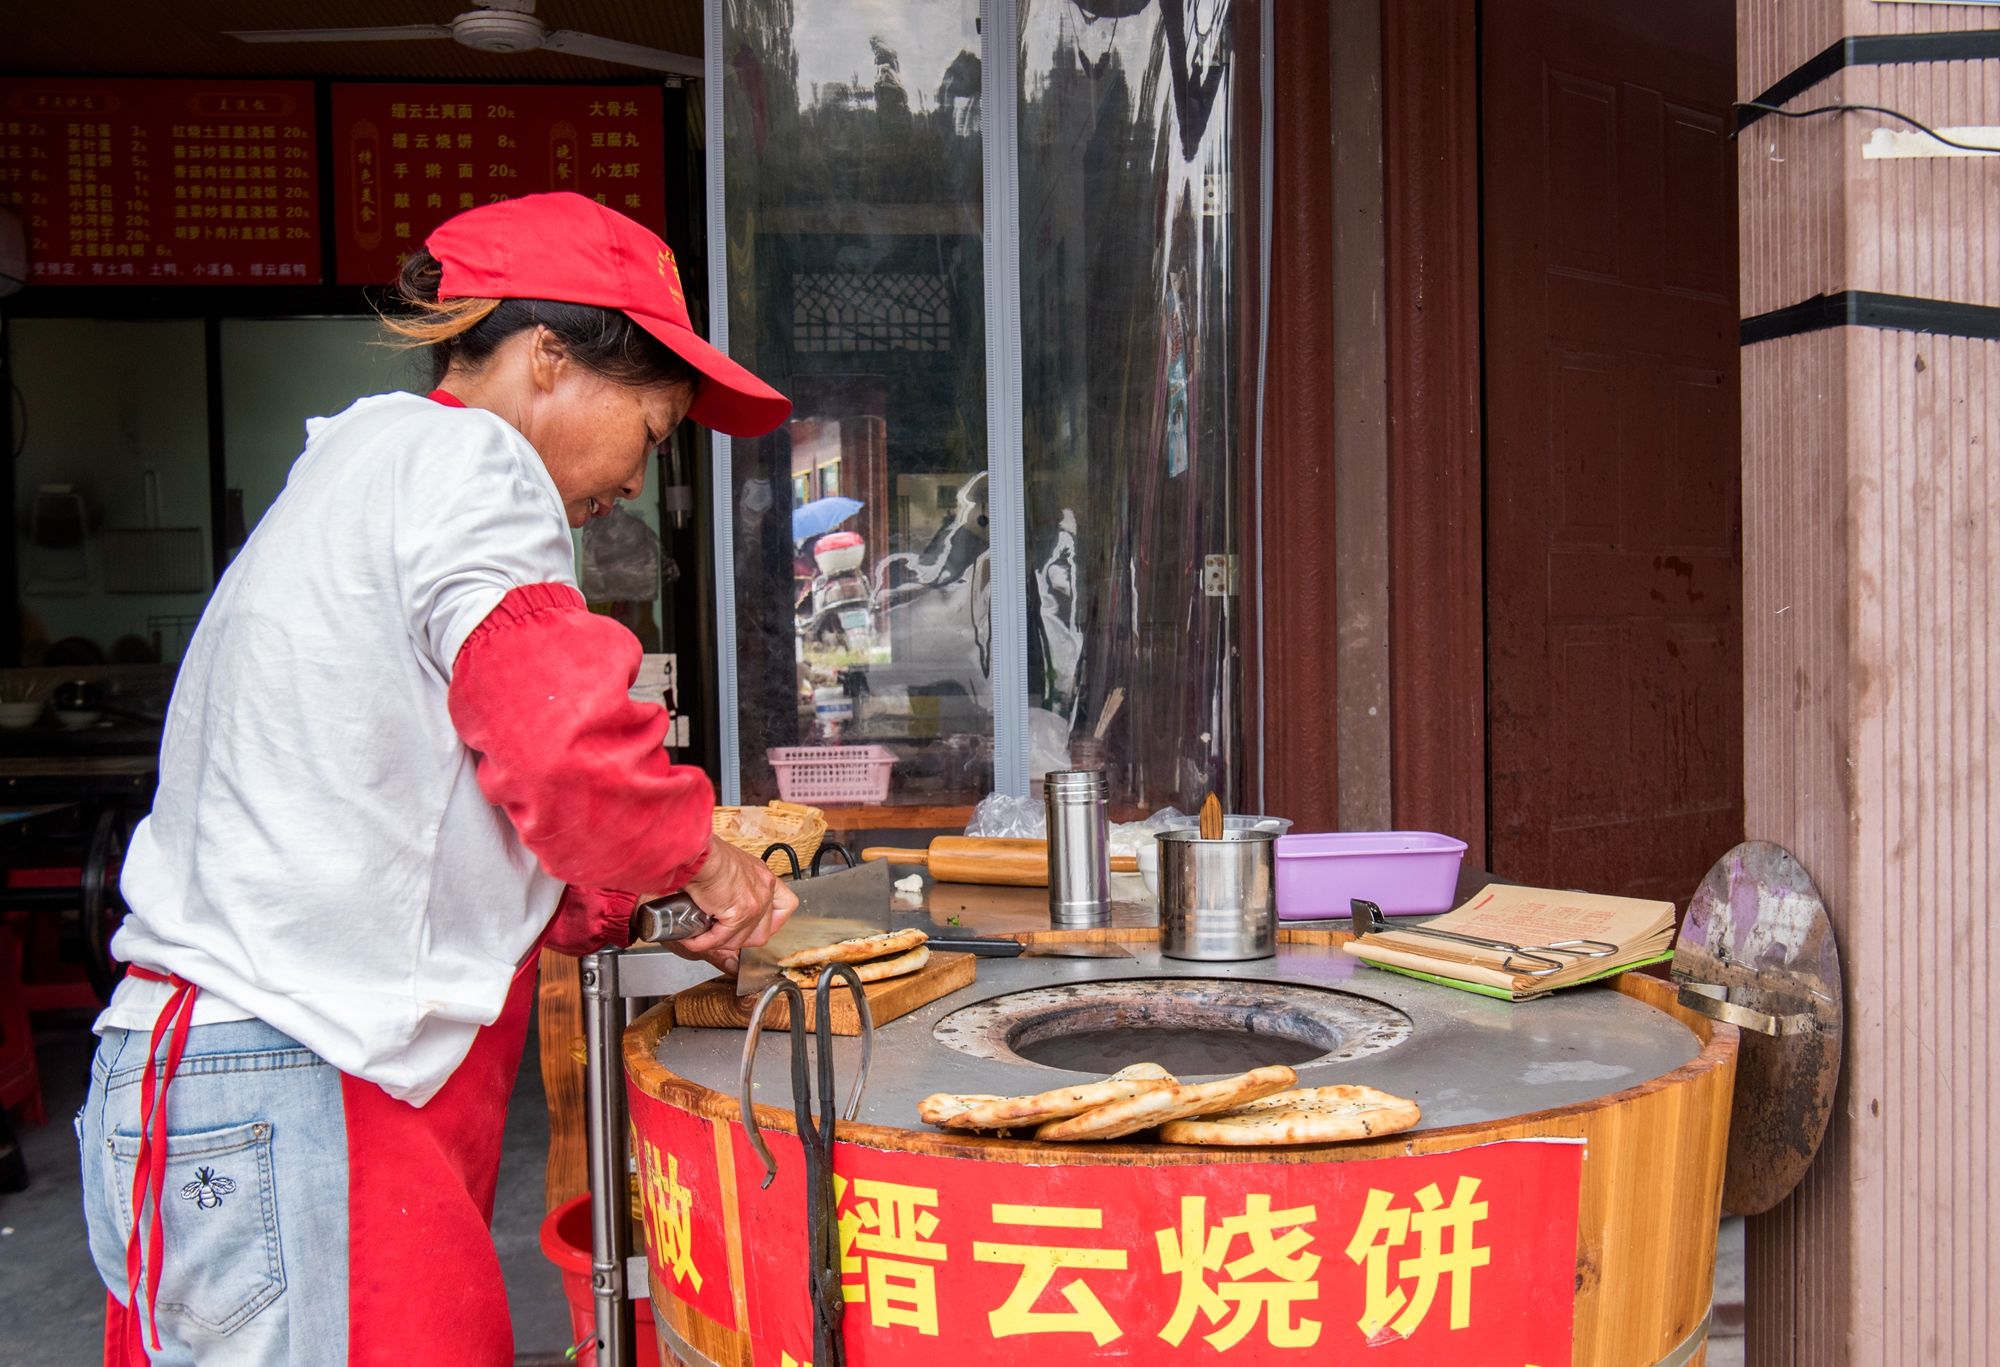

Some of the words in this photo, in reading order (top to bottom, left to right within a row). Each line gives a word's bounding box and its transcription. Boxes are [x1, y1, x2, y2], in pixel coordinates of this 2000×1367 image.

[487, 105, 515, 119] 20元
[589, 101, 639, 117] 大骨头
[392, 132, 473, 150] 缙云烧饼
[498, 135, 516, 149] 8元
[590, 131, 640, 148] 豆腐丸
[488, 164, 518, 178] 20元
[590, 162, 641, 178] 小龙虾
[489, 194, 509, 205] 20
[631, 1118, 703, 1294] 做
[833, 1175, 1491, 1352] 缙云烧饼
